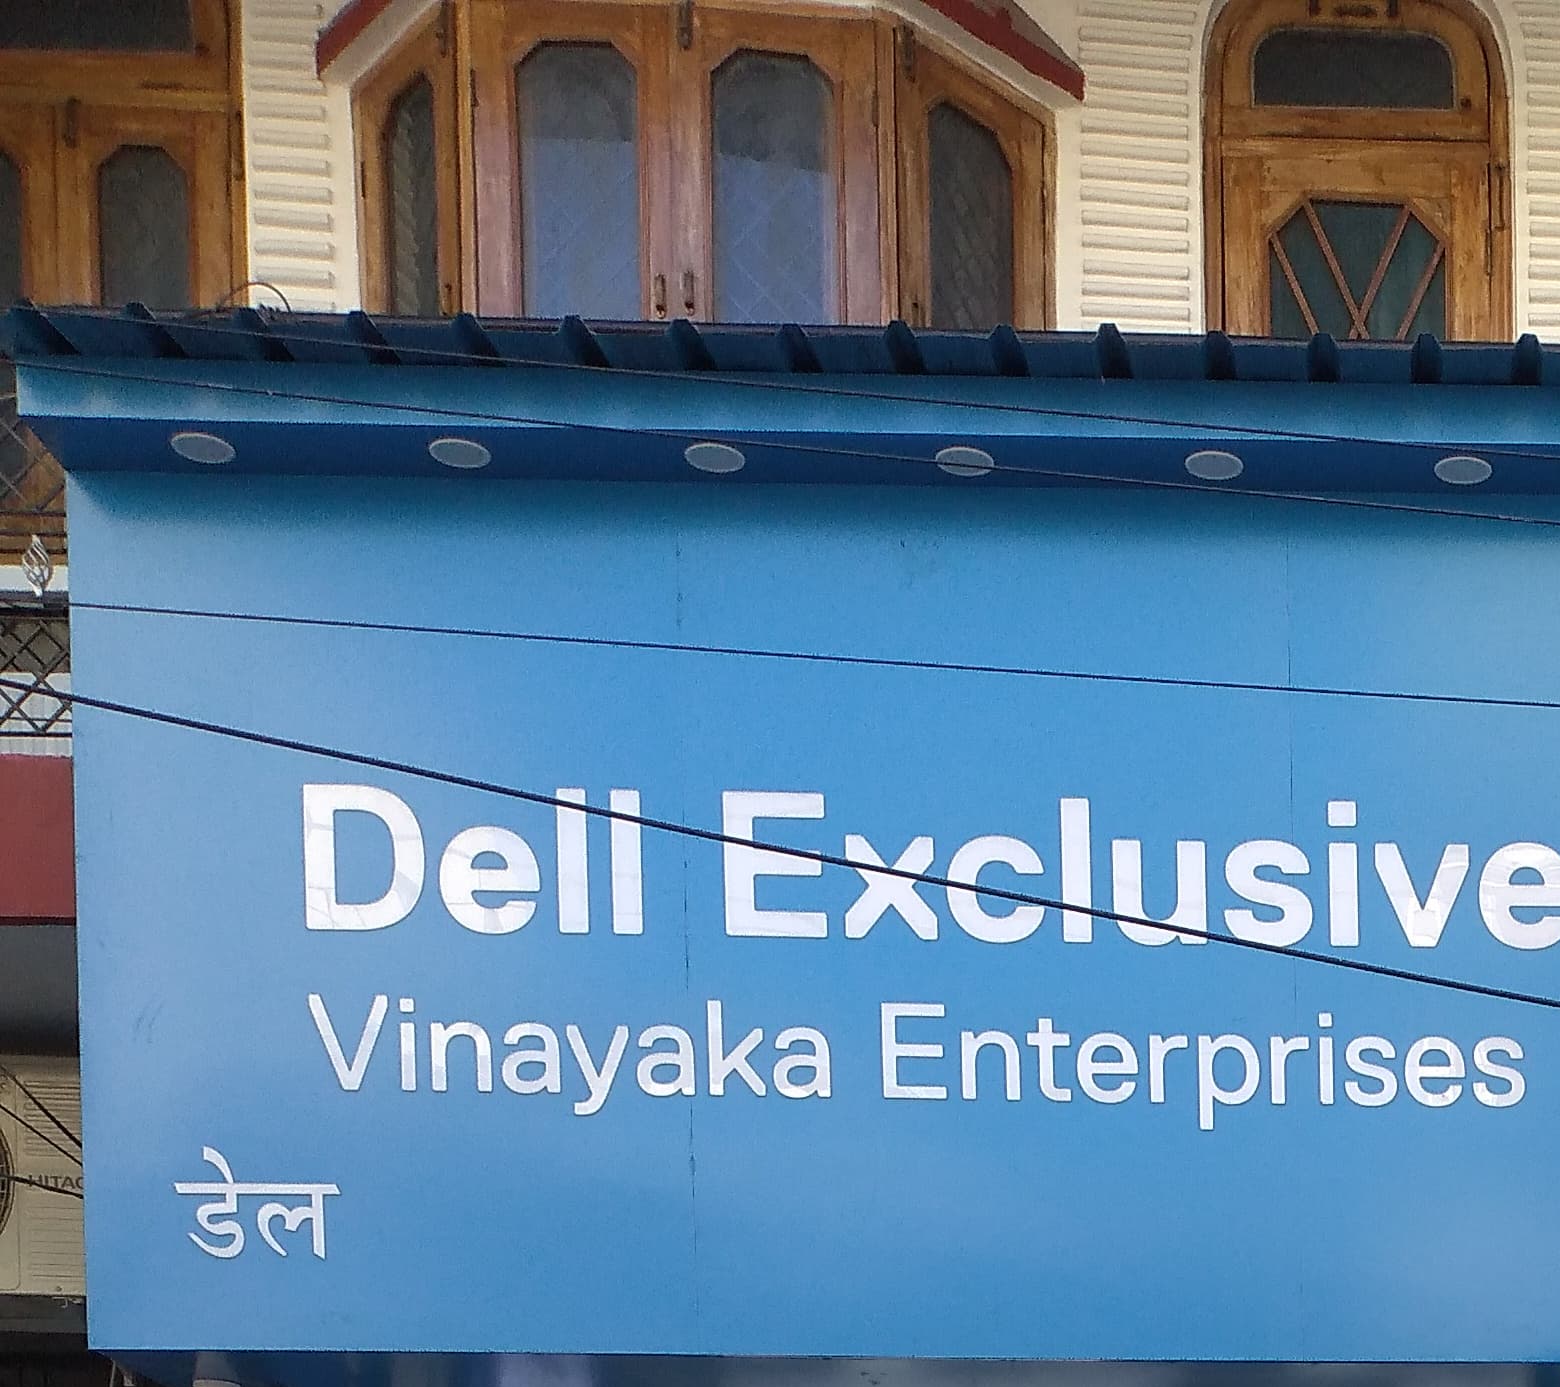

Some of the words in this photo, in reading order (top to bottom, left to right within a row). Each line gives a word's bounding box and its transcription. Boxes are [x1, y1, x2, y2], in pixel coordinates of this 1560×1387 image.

[303, 783, 643, 936] Dell
[309, 994, 832, 1117] Vinayaka
[880, 1002, 1526, 1131] Enterprises
[28, 1175, 84, 1190] HITAC
[173, 1147, 341, 1262] डेल
